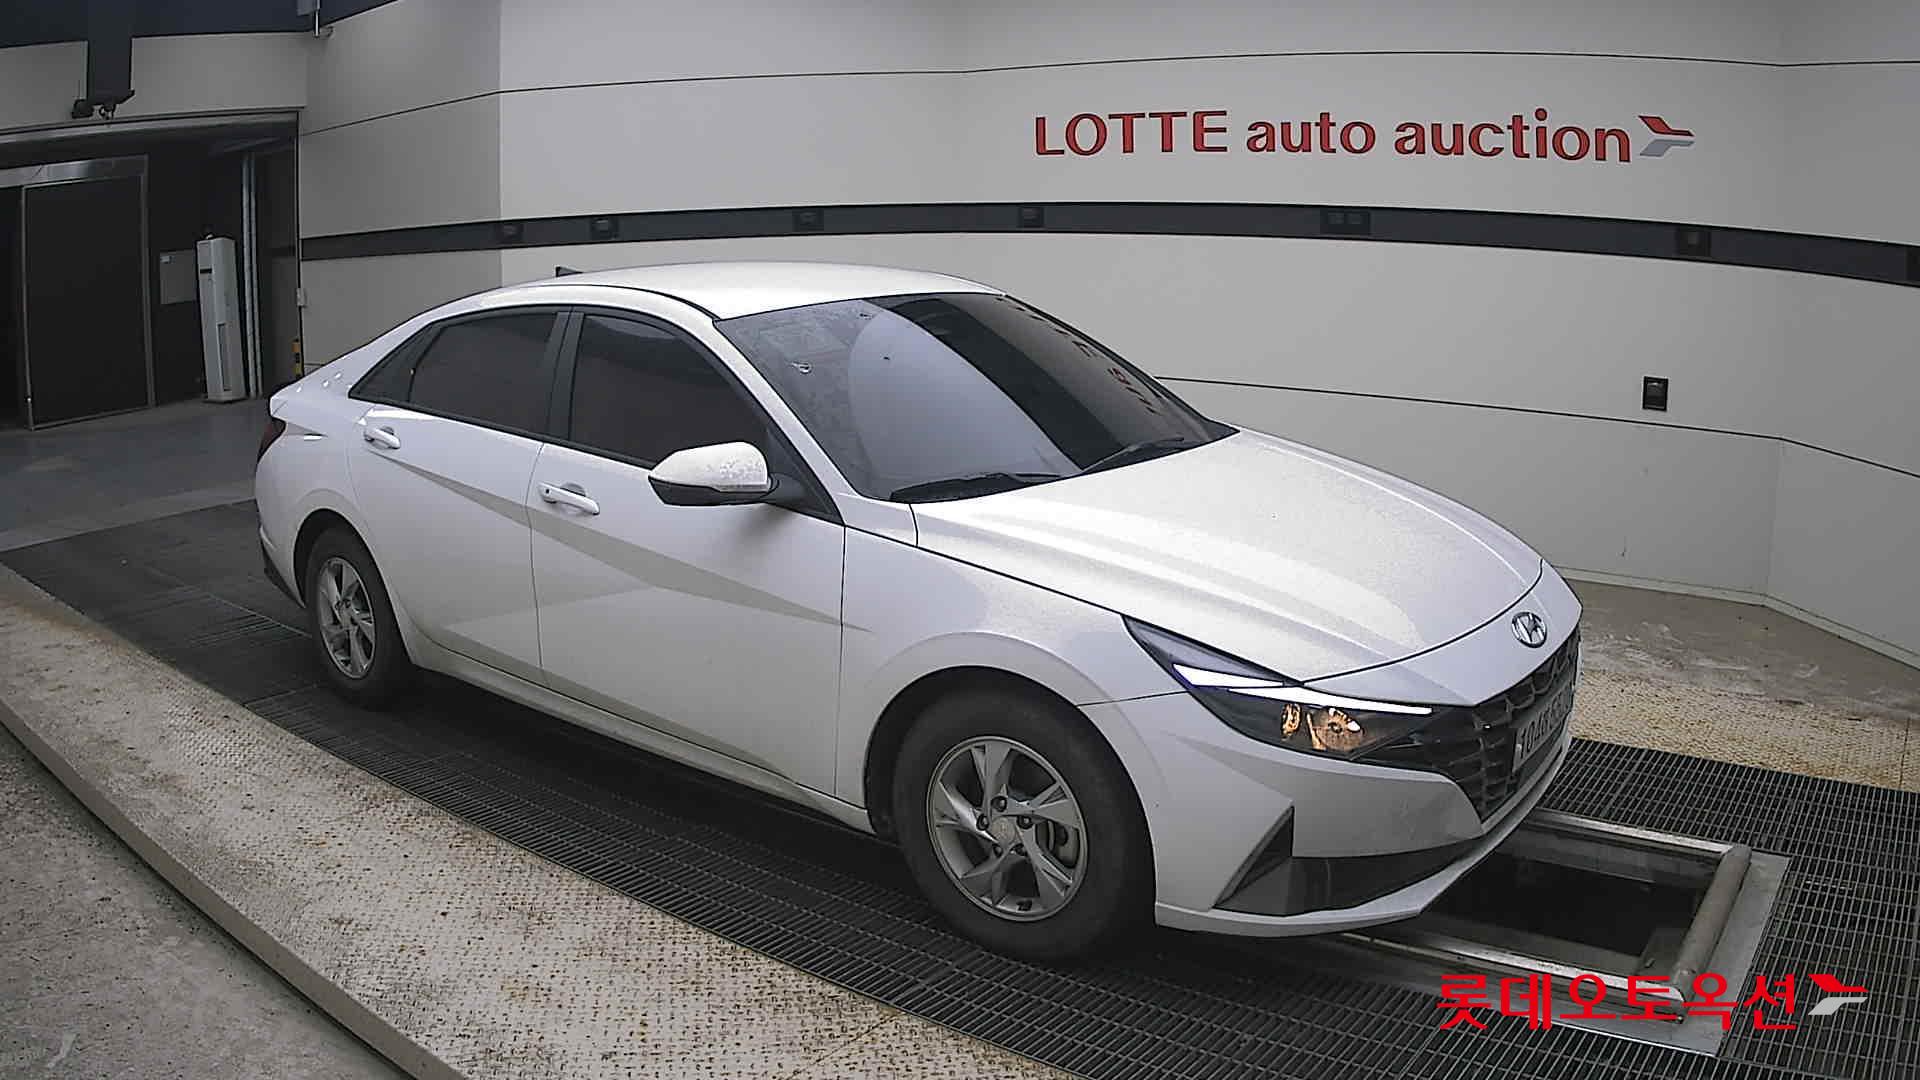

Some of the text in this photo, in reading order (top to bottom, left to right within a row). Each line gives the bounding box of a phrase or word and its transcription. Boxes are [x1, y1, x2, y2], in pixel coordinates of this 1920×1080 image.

[1035, 107, 1632, 163] LOTTE auto auction
